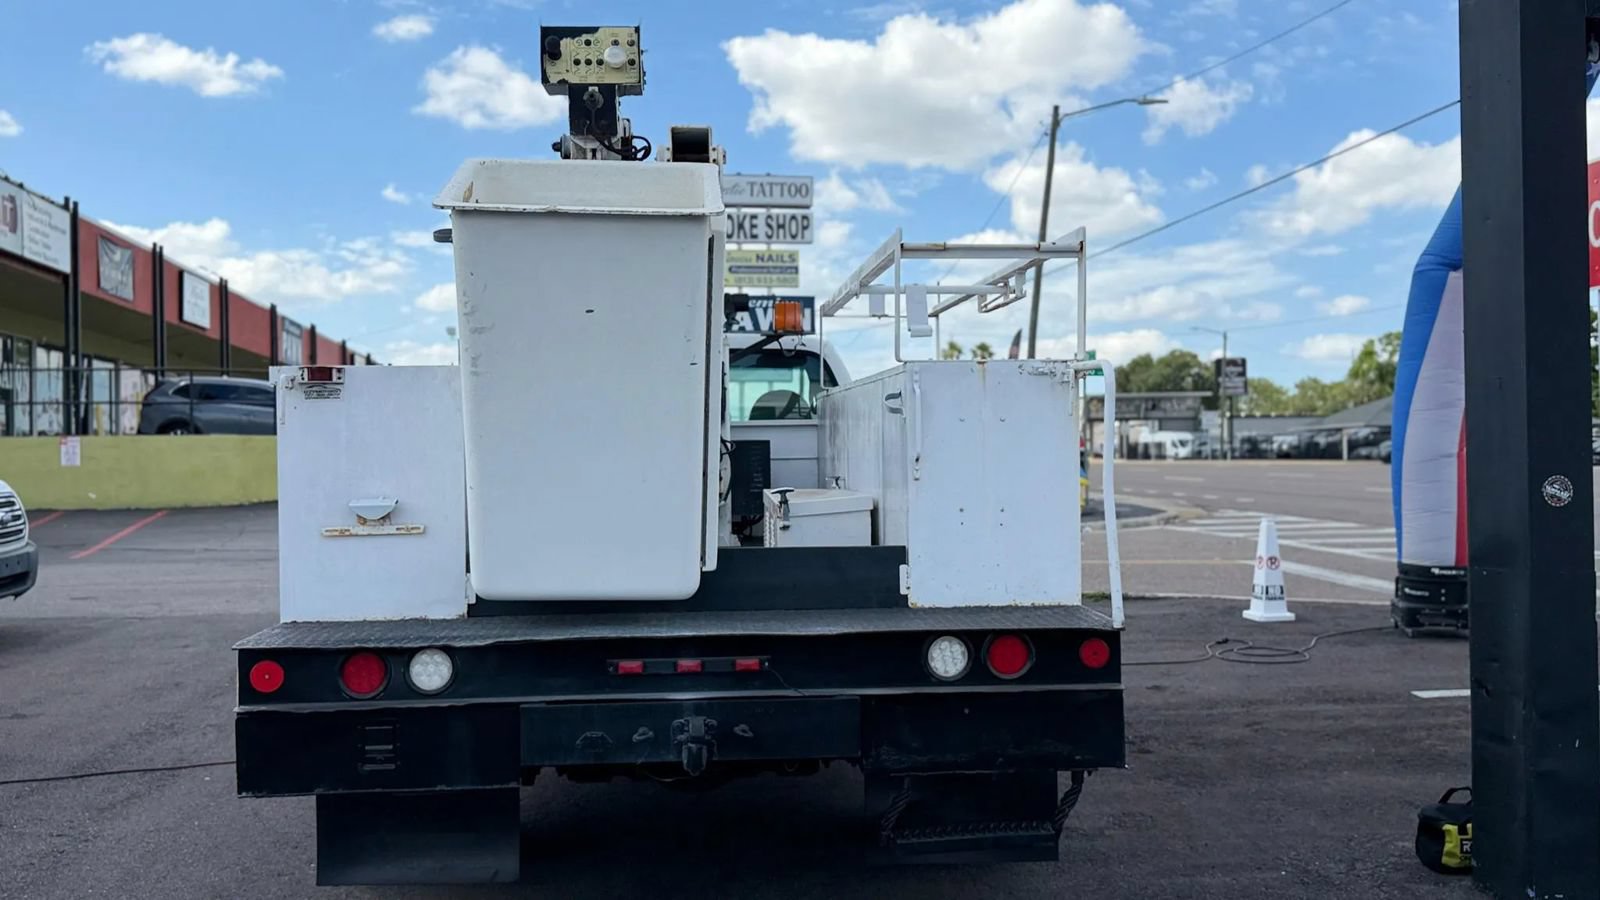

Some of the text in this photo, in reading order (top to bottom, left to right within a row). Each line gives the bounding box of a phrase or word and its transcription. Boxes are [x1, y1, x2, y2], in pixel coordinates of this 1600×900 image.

[747, 181, 810, 198] TATTOO
[765, 214, 810, 240] SHOP
[755, 253, 796, 263] NAILS
